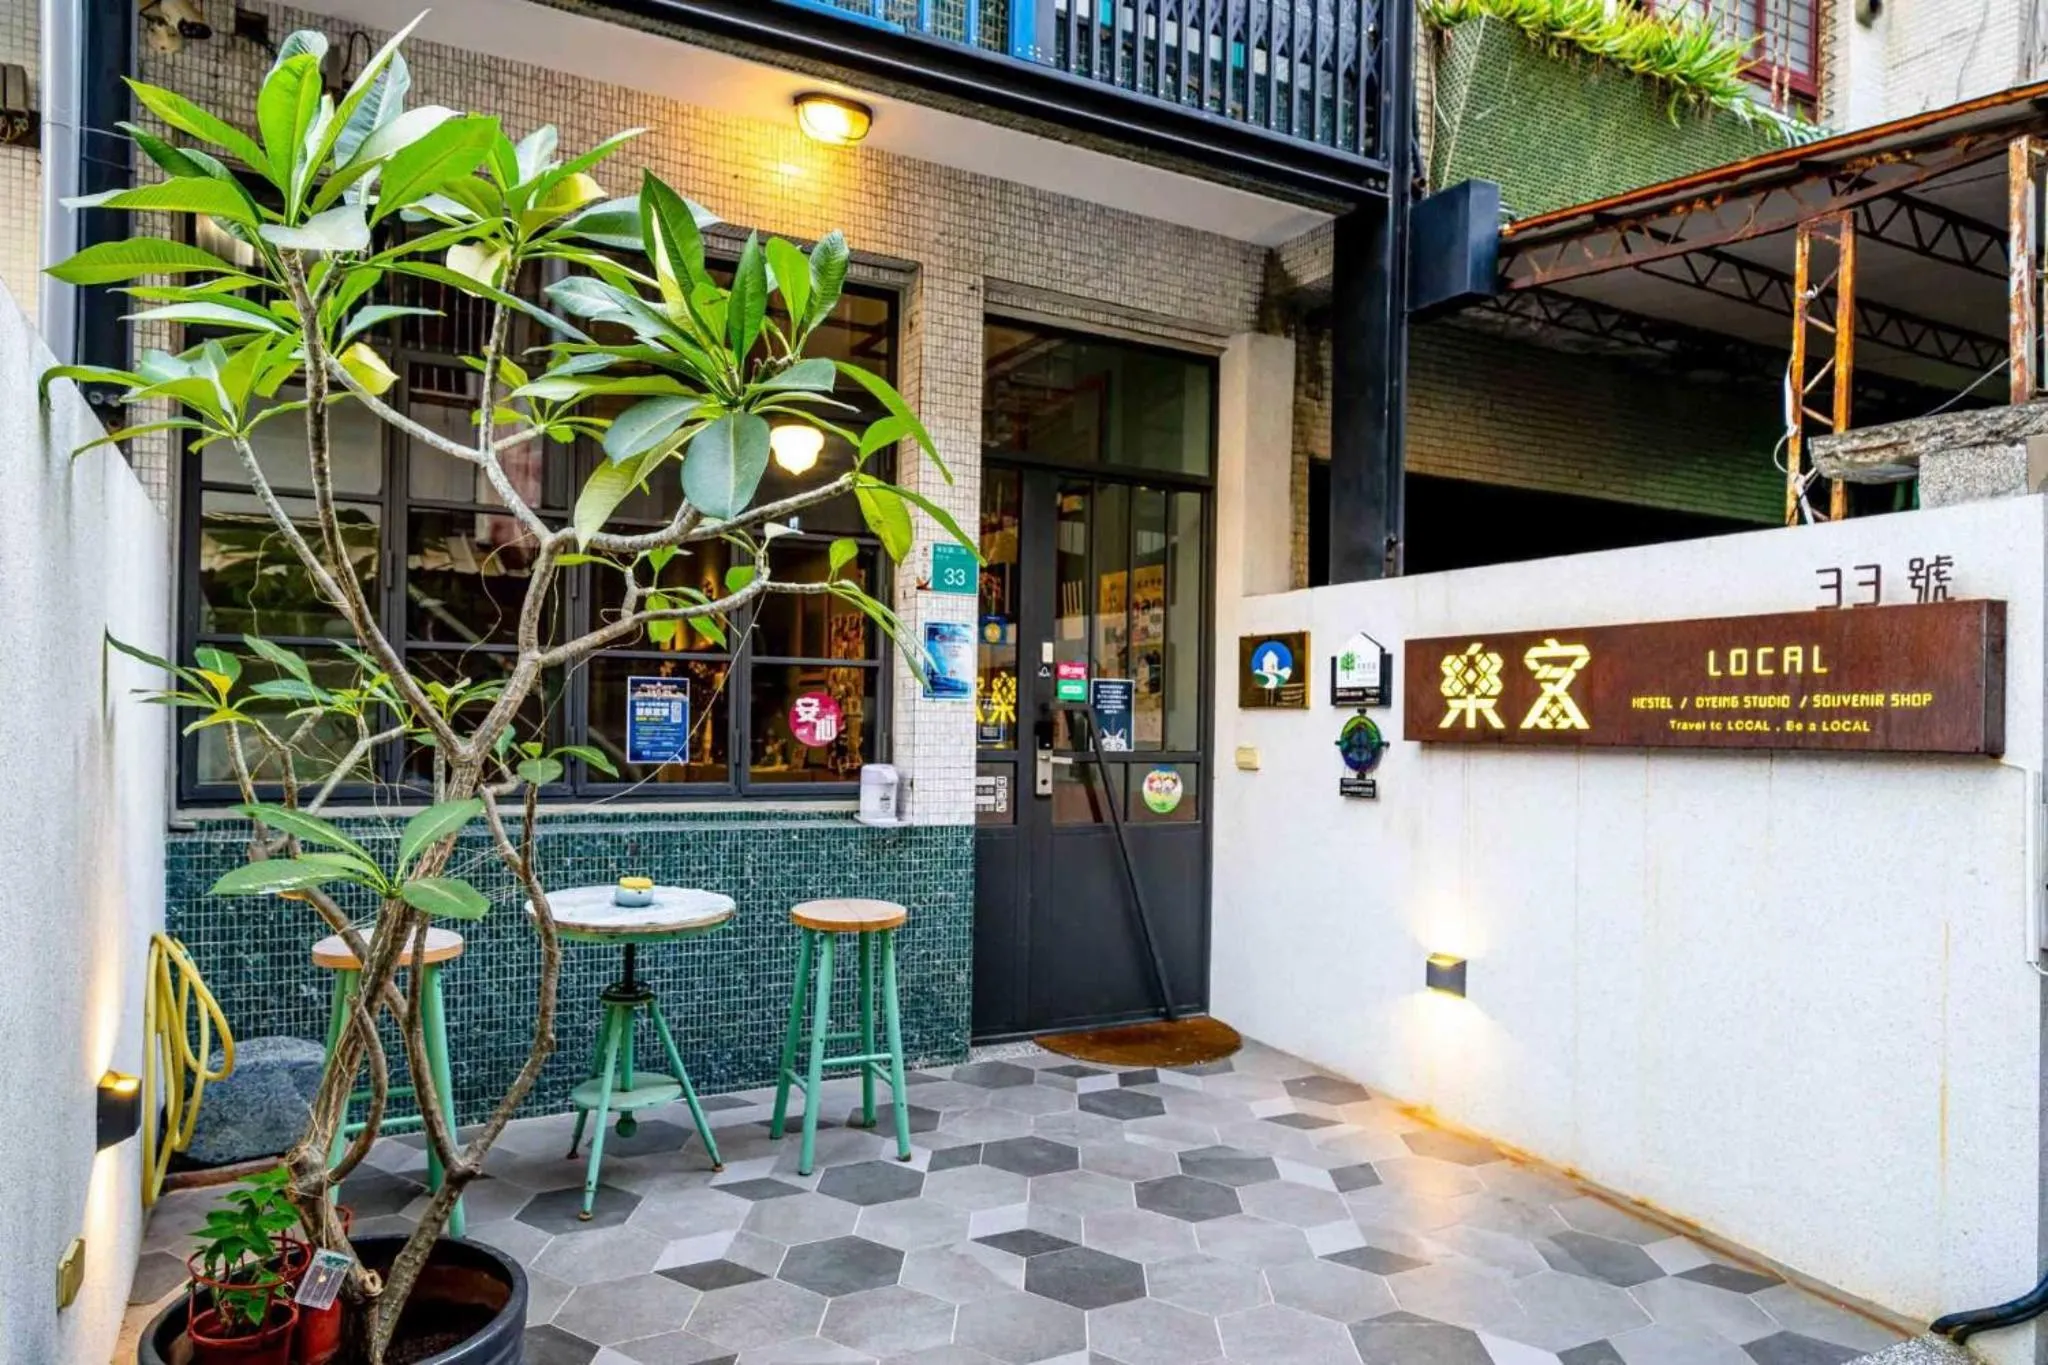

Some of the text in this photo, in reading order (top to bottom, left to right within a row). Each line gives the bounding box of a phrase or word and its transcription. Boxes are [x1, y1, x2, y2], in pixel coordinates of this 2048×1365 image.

[944, 567, 966, 586] 33
[1708, 645, 1828, 676] LOCAL
[1743, 694, 1790, 708] STUDIO
[1812, 694, 1884, 708] SOUVENIR
[1890, 692, 1932, 707] SHOP
[1669, 719, 1706, 731] Travel
[1710, 719, 1722, 731] to
[1727, 719, 1771, 732] LOCAL
[1786, 718, 1803, 732] Be
[1822, 719, 1871, 732] LOCAL
